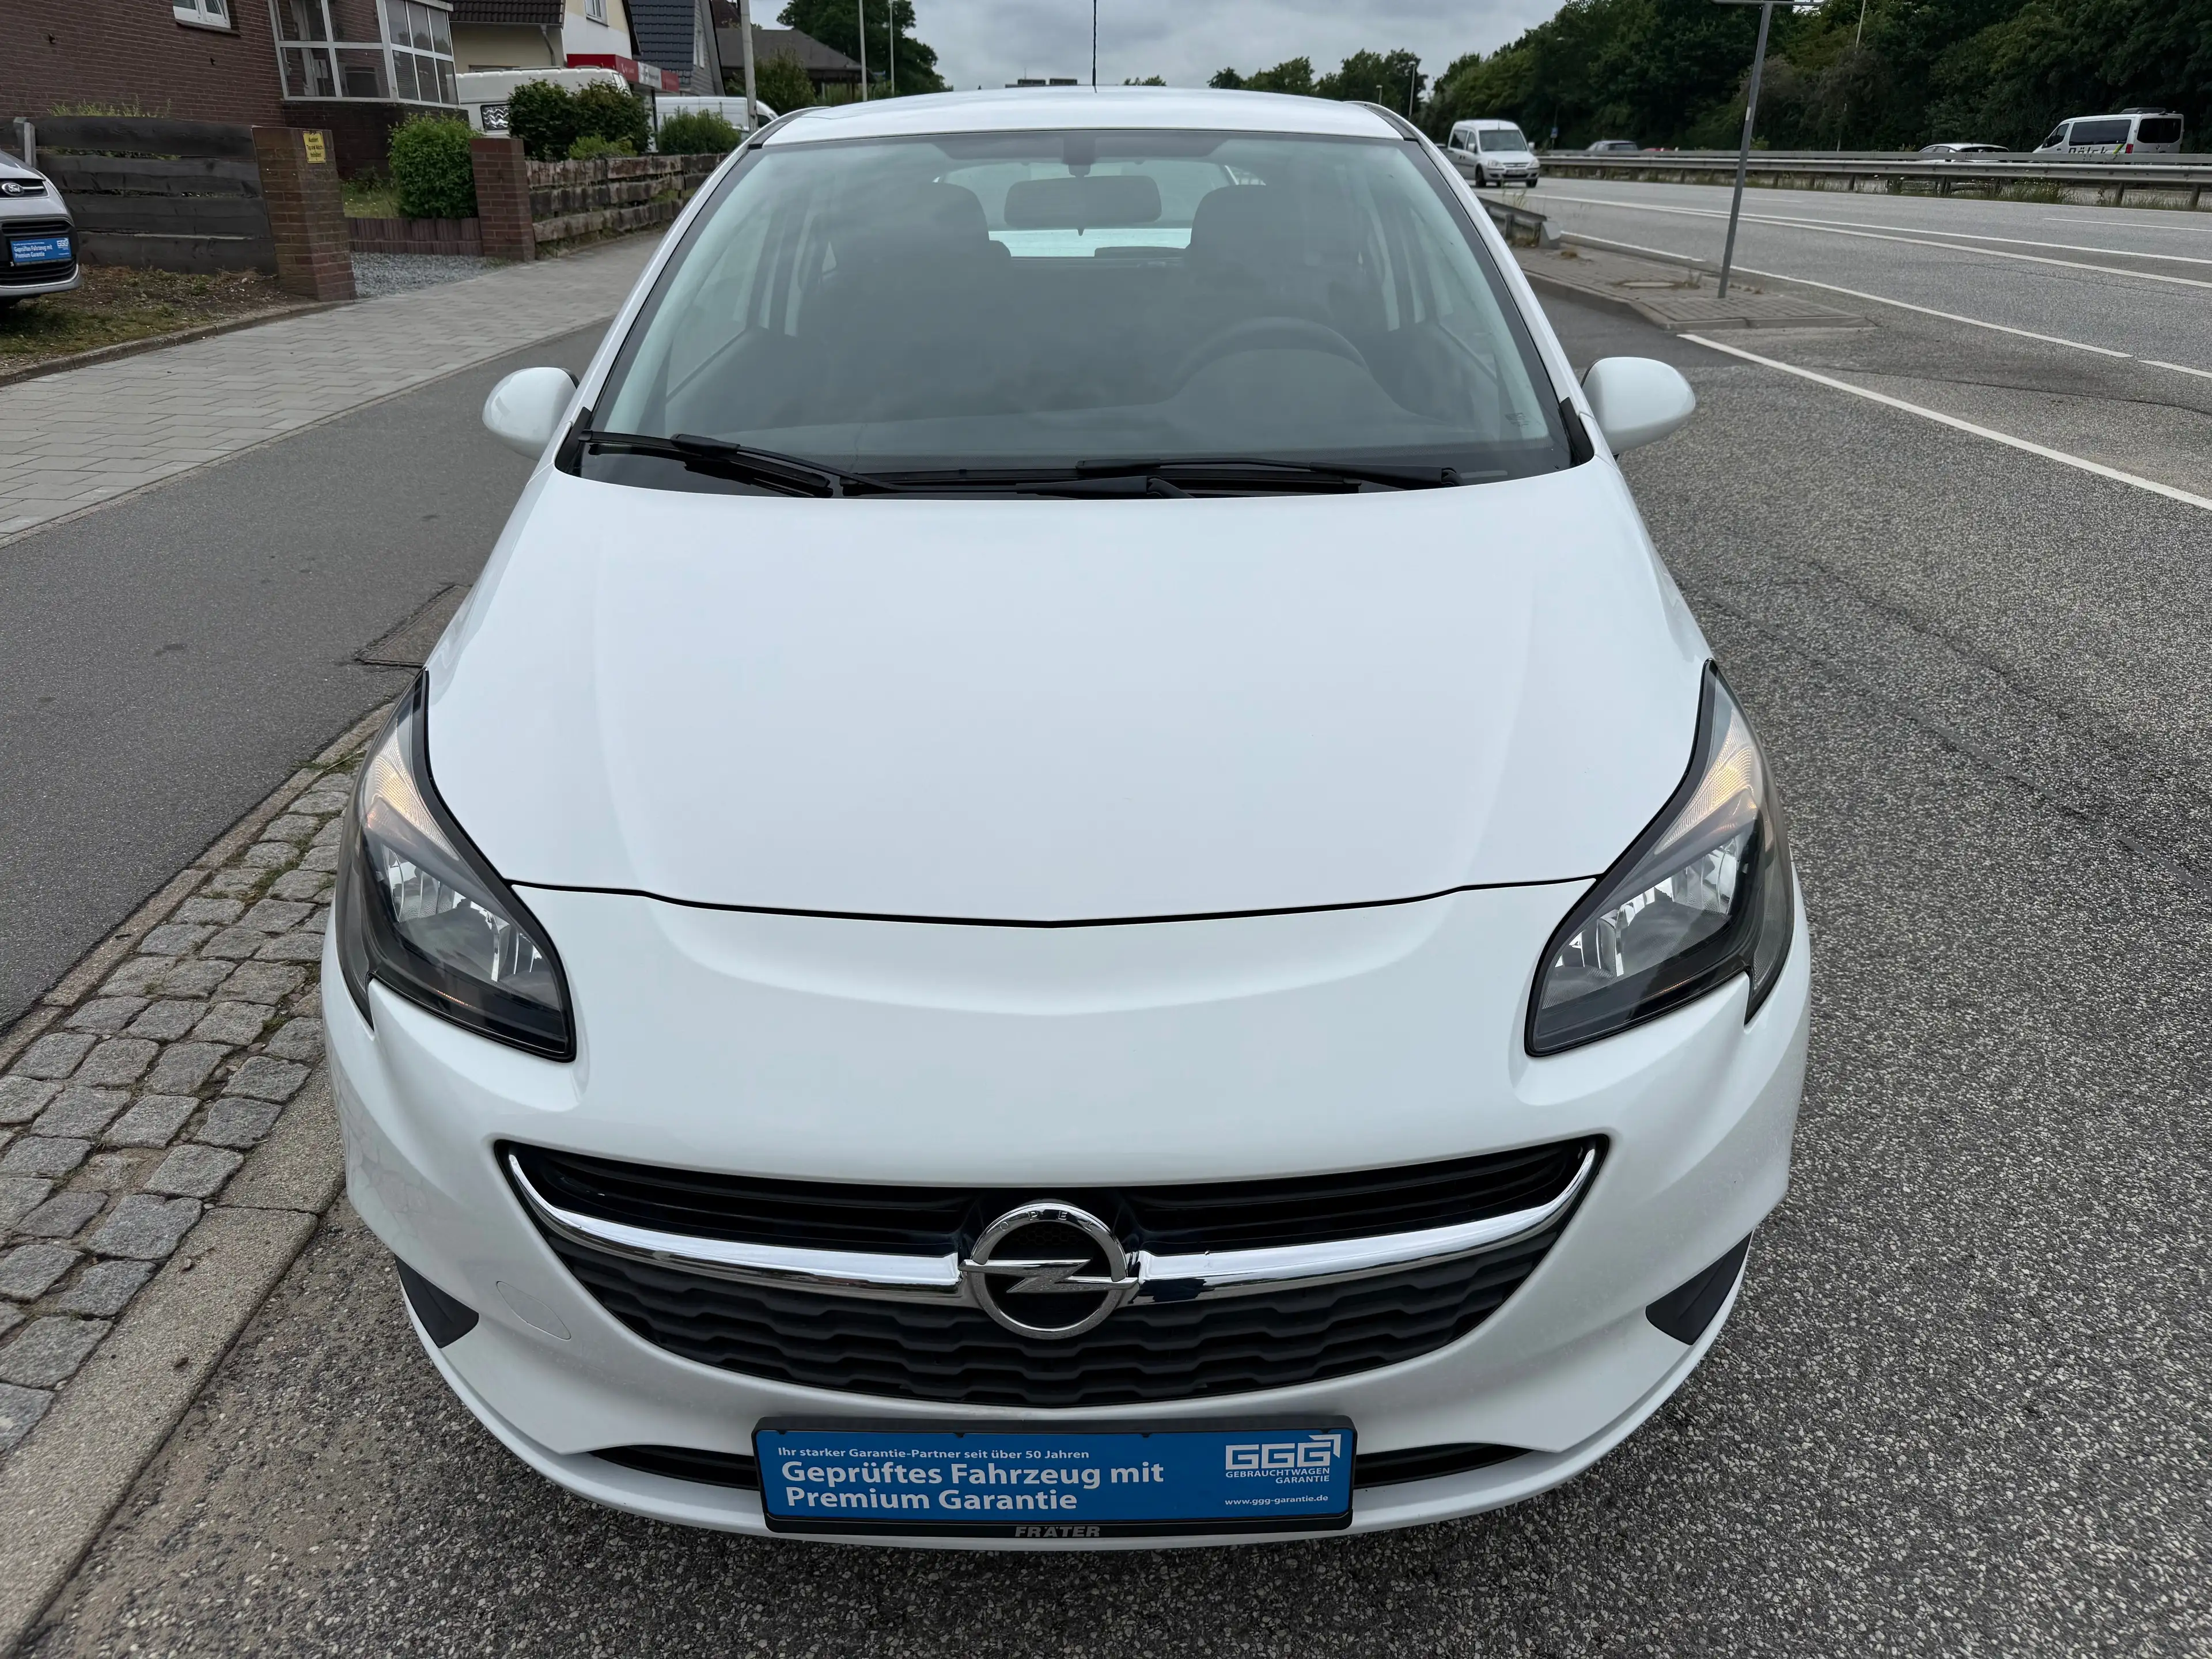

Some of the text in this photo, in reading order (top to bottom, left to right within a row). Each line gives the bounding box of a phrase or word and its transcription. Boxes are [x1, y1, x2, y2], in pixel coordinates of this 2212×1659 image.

[8, 184, 21, 192] Ford
[999, 1210, 1093, 1232] OPEL
[778, 1447, 796, 1456] Ihr
[800, 1448, 846, 1457] starker
[849, 1449, 960, 1458] Garantie-Partner
[991, 1450, 1021, 1459] über
[1025, 1450, 1041, 1459] 50
[1044, 1450, 1089, 1459] Jahren
[1225, 1441, 1331, 1470] GGG
[782, 1461, 1164, 1489] Geprüftes Fahrzeug mit
[1225, 1467, 1330, 1478] GEBRAUCHTWAGEN
[1275, 1475, 1330, 1484] GARANTIE
[786, 1487, 1077, 1510] Premium Garantie
[1225, 1495, 1328, 1505] www.ggg-garantie.de
[1014, 1525, 1101, 1538] FRÄTER
